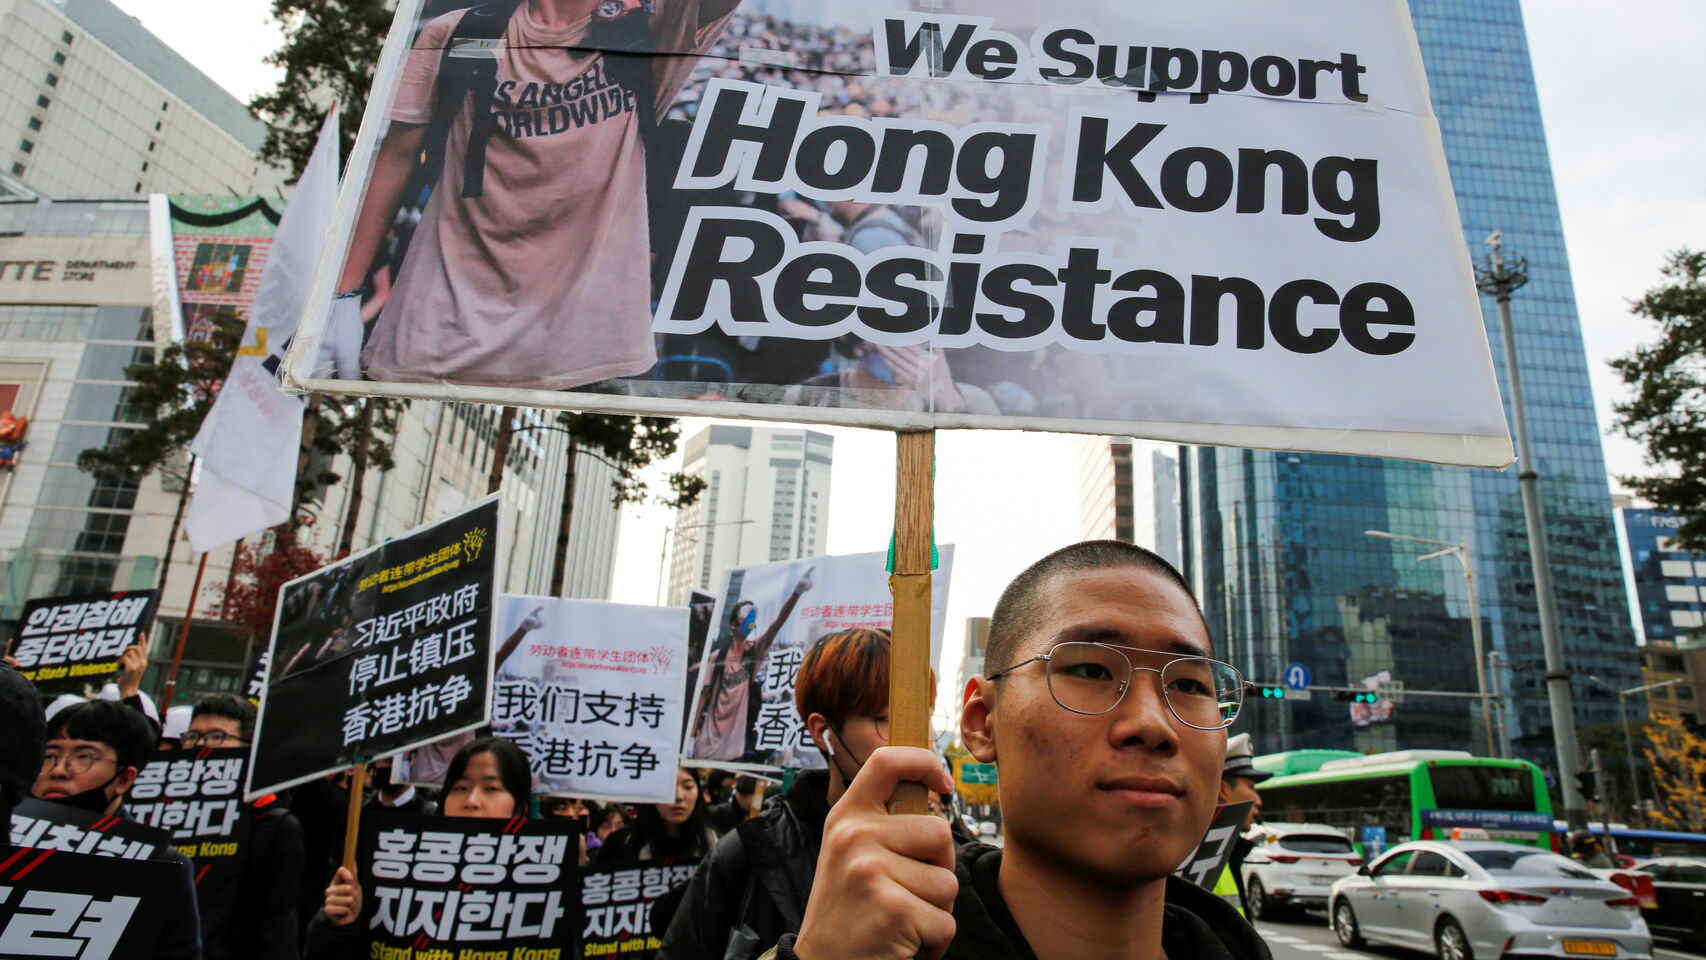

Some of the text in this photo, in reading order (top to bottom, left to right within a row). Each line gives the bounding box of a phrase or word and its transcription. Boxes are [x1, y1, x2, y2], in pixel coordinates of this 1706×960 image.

[885, 19, 1368, 104] We Support
[691, 88, 1381, 243] Hong Kong
[62, 271, 96, 281] STORE
[65, 260, 136, 270] DEPARTMENT
[669, 219, 1416, 356] Resistance
[21, 597, 149, 637] 인권침해
[352, 584, 479, 647] 习近平政府
[14, 628, 136, 667] 중단하라
[349, 619, 477, 696] 停止镇压
[343, 675, 472, 747] 香港抗争
[498, 684, 665, 729] 我们支持
[200, 842, 238, 856] Kong
[371, 829, 568, 884] 홍콩항쟁
[370, 886, 564, 941] 지지한다
[582, 901, 654, 939] 지지
[371, 941, 561, 960] Stand with Hong Kong
[584, 940, 618, 957] Stand
[620, 938, 645, 953] with
